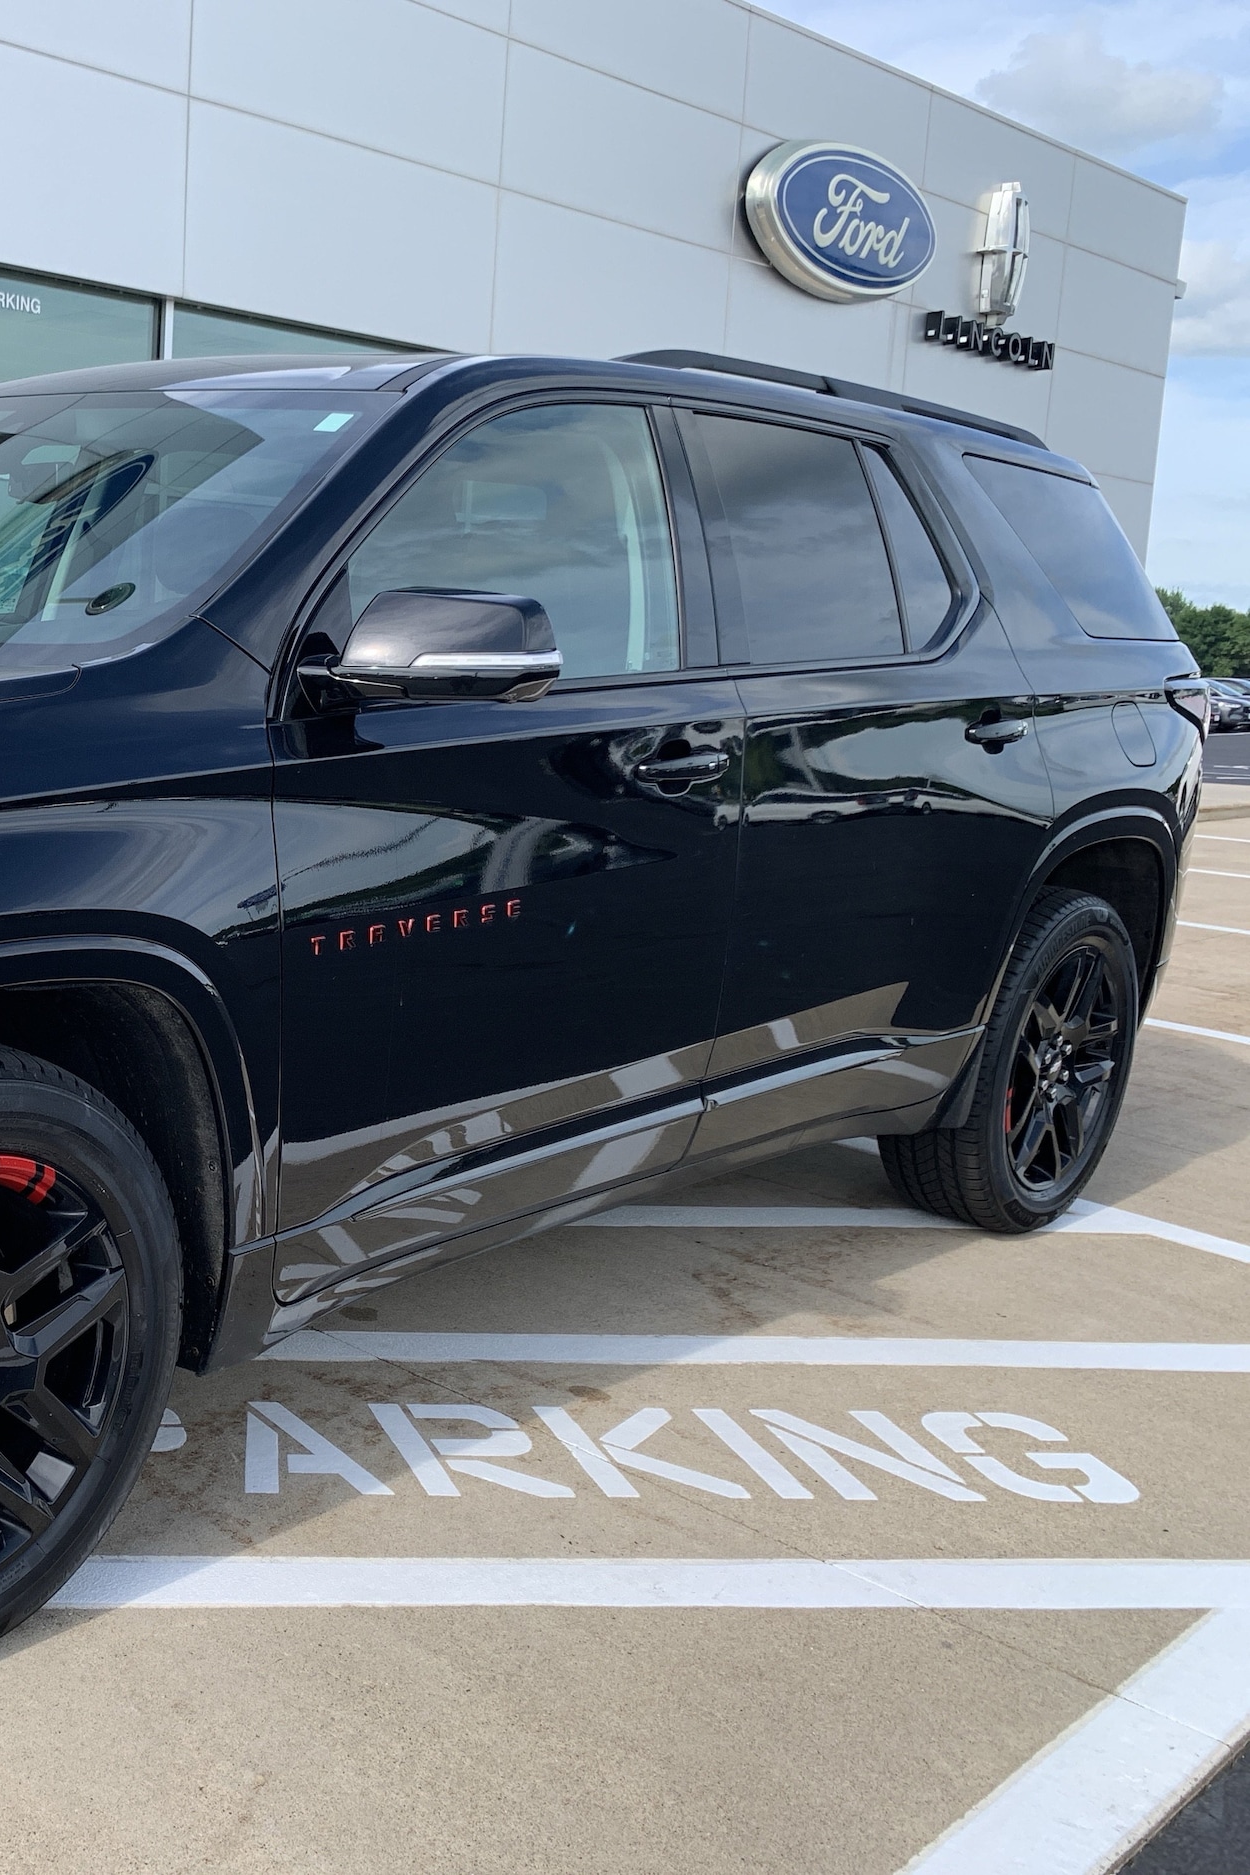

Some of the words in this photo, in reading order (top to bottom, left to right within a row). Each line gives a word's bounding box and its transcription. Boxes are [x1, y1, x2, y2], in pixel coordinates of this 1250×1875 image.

[813, 174, 910, 268] Ford
[925, 311, 1055, 370] LINCOLN
[310, 900, 521, 955] TRAVERSE
